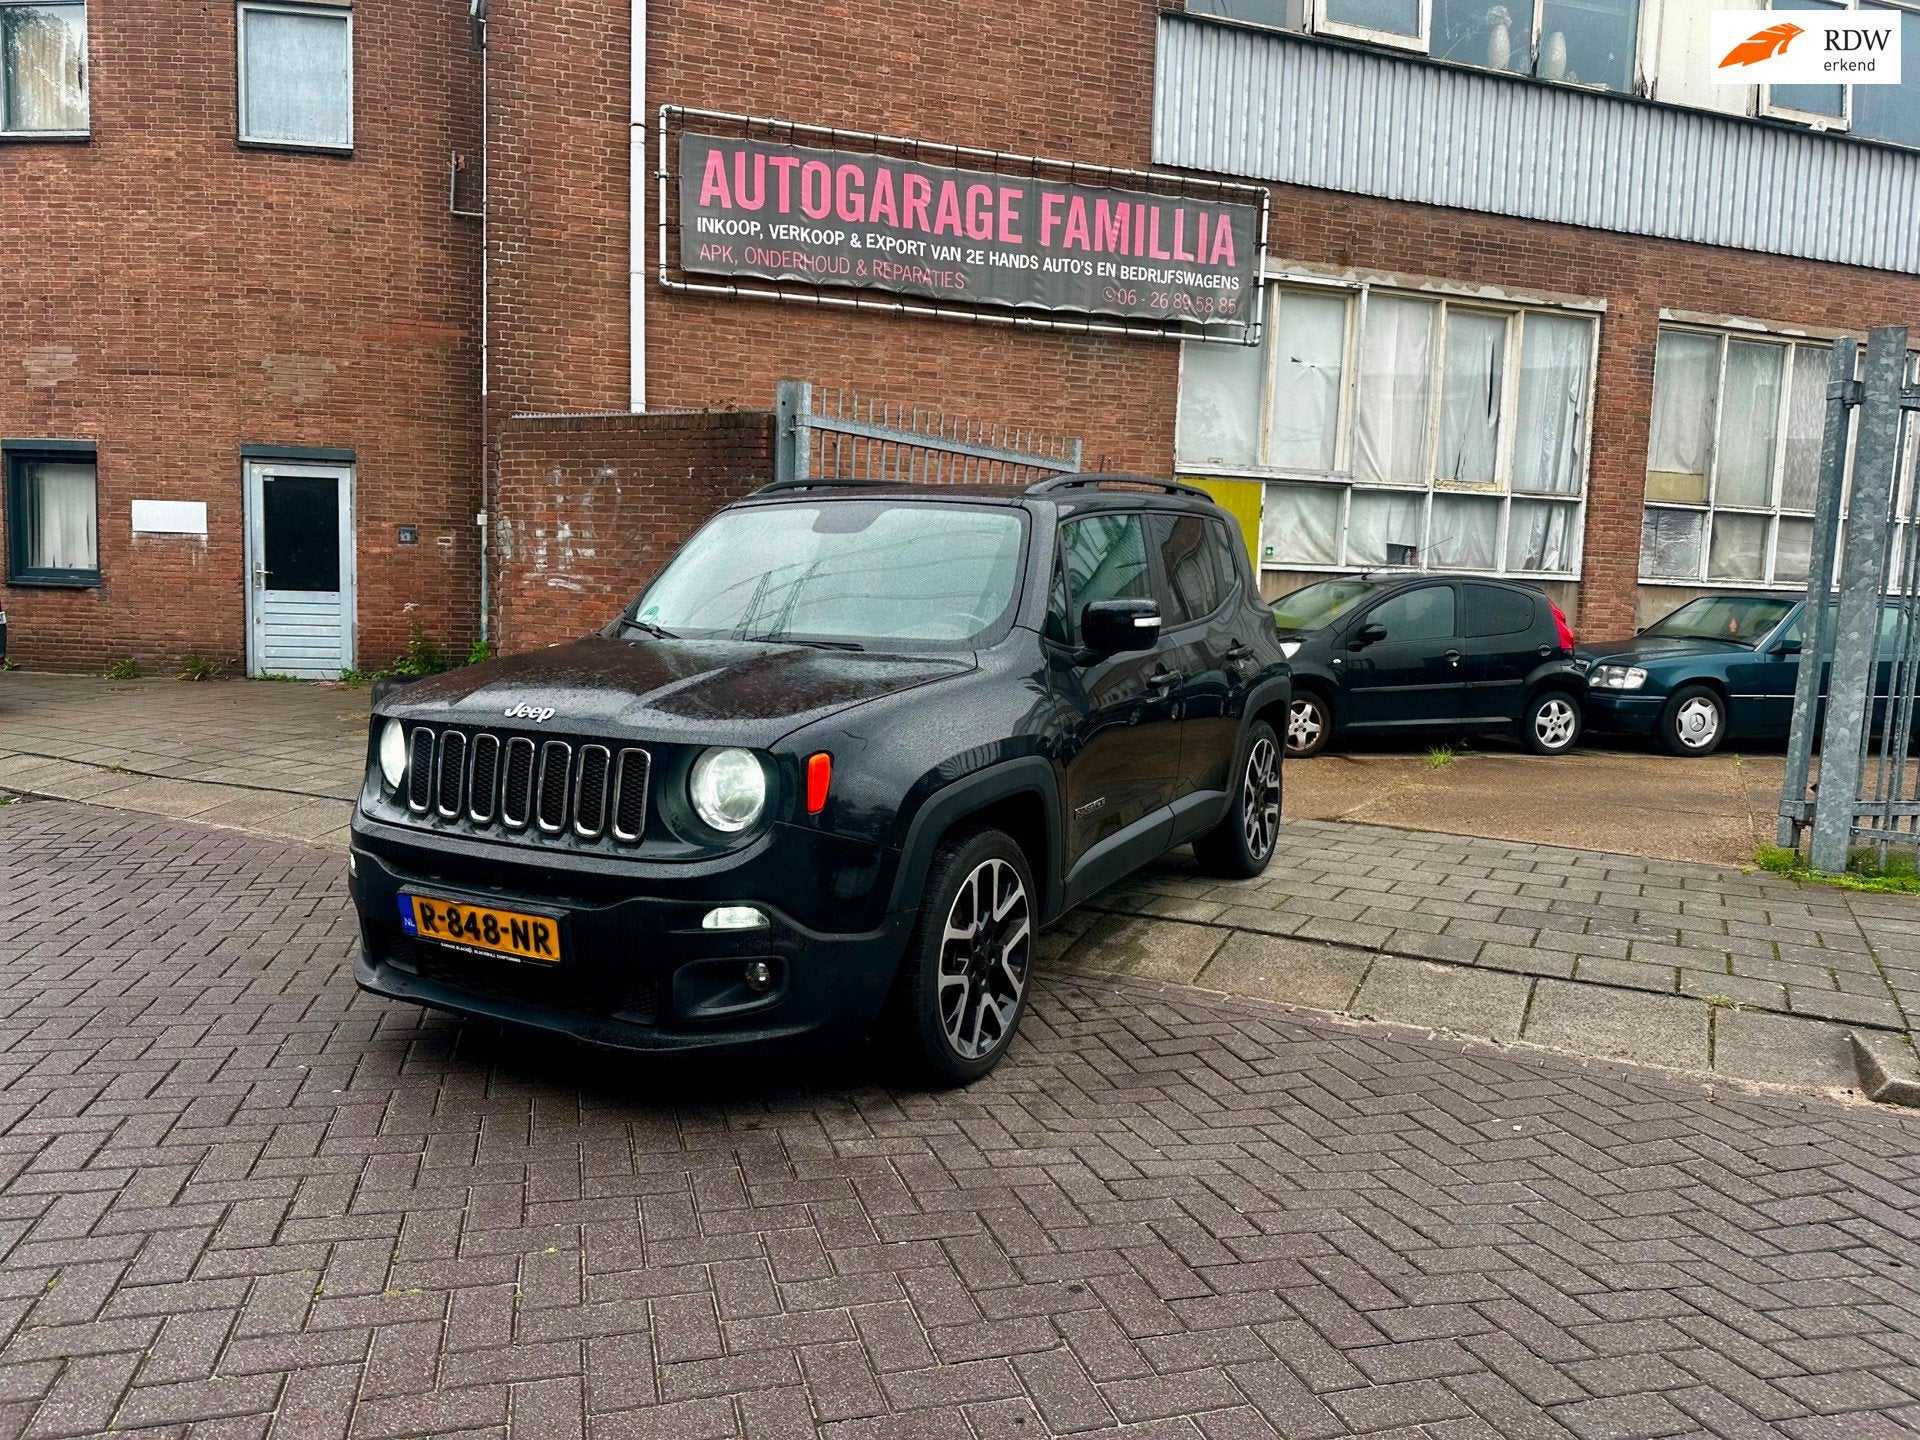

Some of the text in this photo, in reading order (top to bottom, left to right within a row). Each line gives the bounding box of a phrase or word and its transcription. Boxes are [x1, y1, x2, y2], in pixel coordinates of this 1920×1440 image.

[699, 150, 1236, 267] AUTOGARAGE FAMILLIA
[697, 216, 1240, 291] INKOOP, VERKOOP & EXPORT VAN 2E HANDS AUTO'S EN BEDRIJFSWAGENS
[699, 243, 965, 290] APK, ONDERHOUD & REPARATIES
[1117, 288, 1137, 306] 06
[1150, 291, 1169, 309] 26
[1173, 292, 1191, 310] 89
[1196, 296, 1214, 313] 58
[1219, 297, 1236, 314] 85
[504, 702, 556, 723] Jeep
[403, 917, 415, 927] NL
[418, 901, 552, 956] R-848-NR
